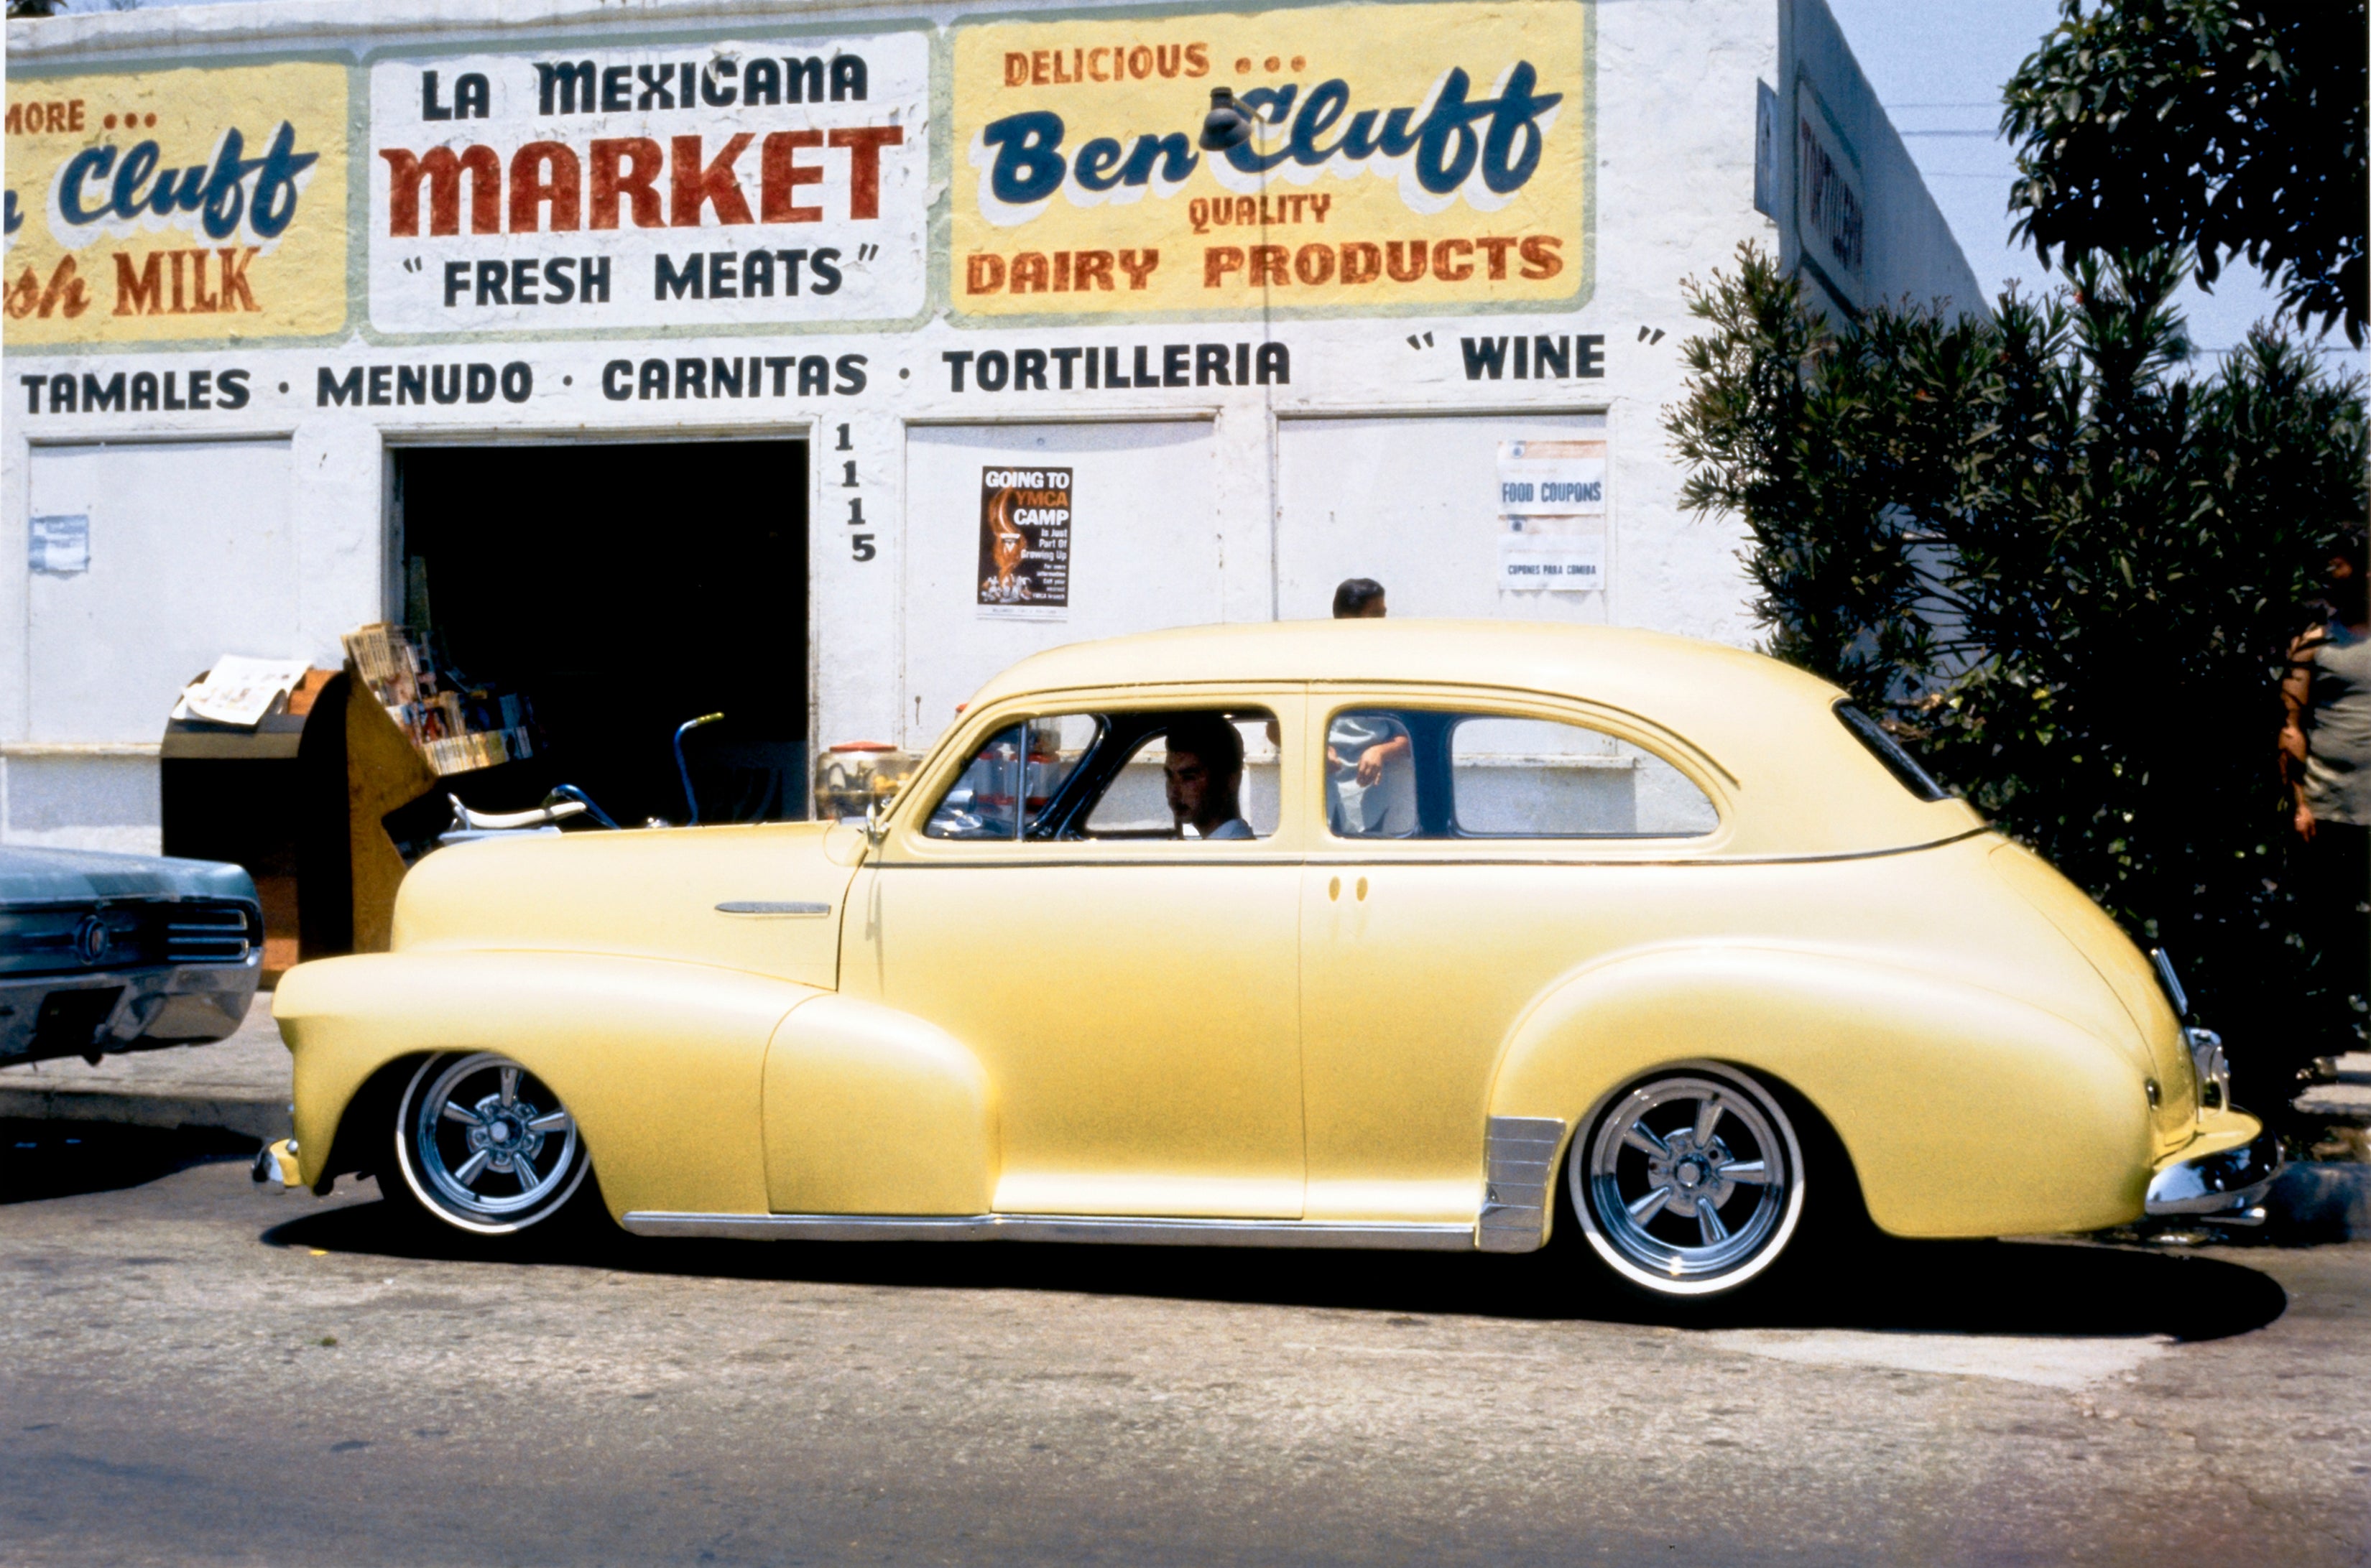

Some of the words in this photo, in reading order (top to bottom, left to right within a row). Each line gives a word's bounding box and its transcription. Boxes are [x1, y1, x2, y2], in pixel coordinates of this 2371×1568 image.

[1004, 43, 1209, 87] DELICIOUS
[422, 70, 491, 122] LA
[532, 54, 868, 116] MEXICANA
[984, 111, 1196, 203] Ben
[1224, 59, 1564, 194] Cluff
[57, 119, 320, 239] Cluff
[378, 125, 904, 237] MARKET
[1188, 192, 1331, 234] QUALITY
[111, 246, 261, 316] MILK
[966, 248, 1160, 295] DAIRY
[1203, 235, 1563, 288] PRODUCTS
[20, 368, 251, 414] TAMALES
[316, 361, 534, 407] MENUDO
[601, 353, 869, 402] CARNITAS
[941, 341, 1290, 393] TORTILLERIA
[835, 423, 877, 562] 1115
[985, 470, 1044, 488] GOING
[1047, 472, 1070, 490] TO
[1015, 491, 1069, 507] YMCA
[1502, 482, 1534, 503] FOOD
[1541, 481, 1602, 502] COUPONS
[1013, 509, 1070, 526] CAMP
[1020, 549, 1054, 561] Growing
[1056, 550, 1066, 561] Up
[1039, 539, 1055, 548] Part
[1058, 539, 1067, 548] Of
[1543, 565, 1563, 575] PARA
